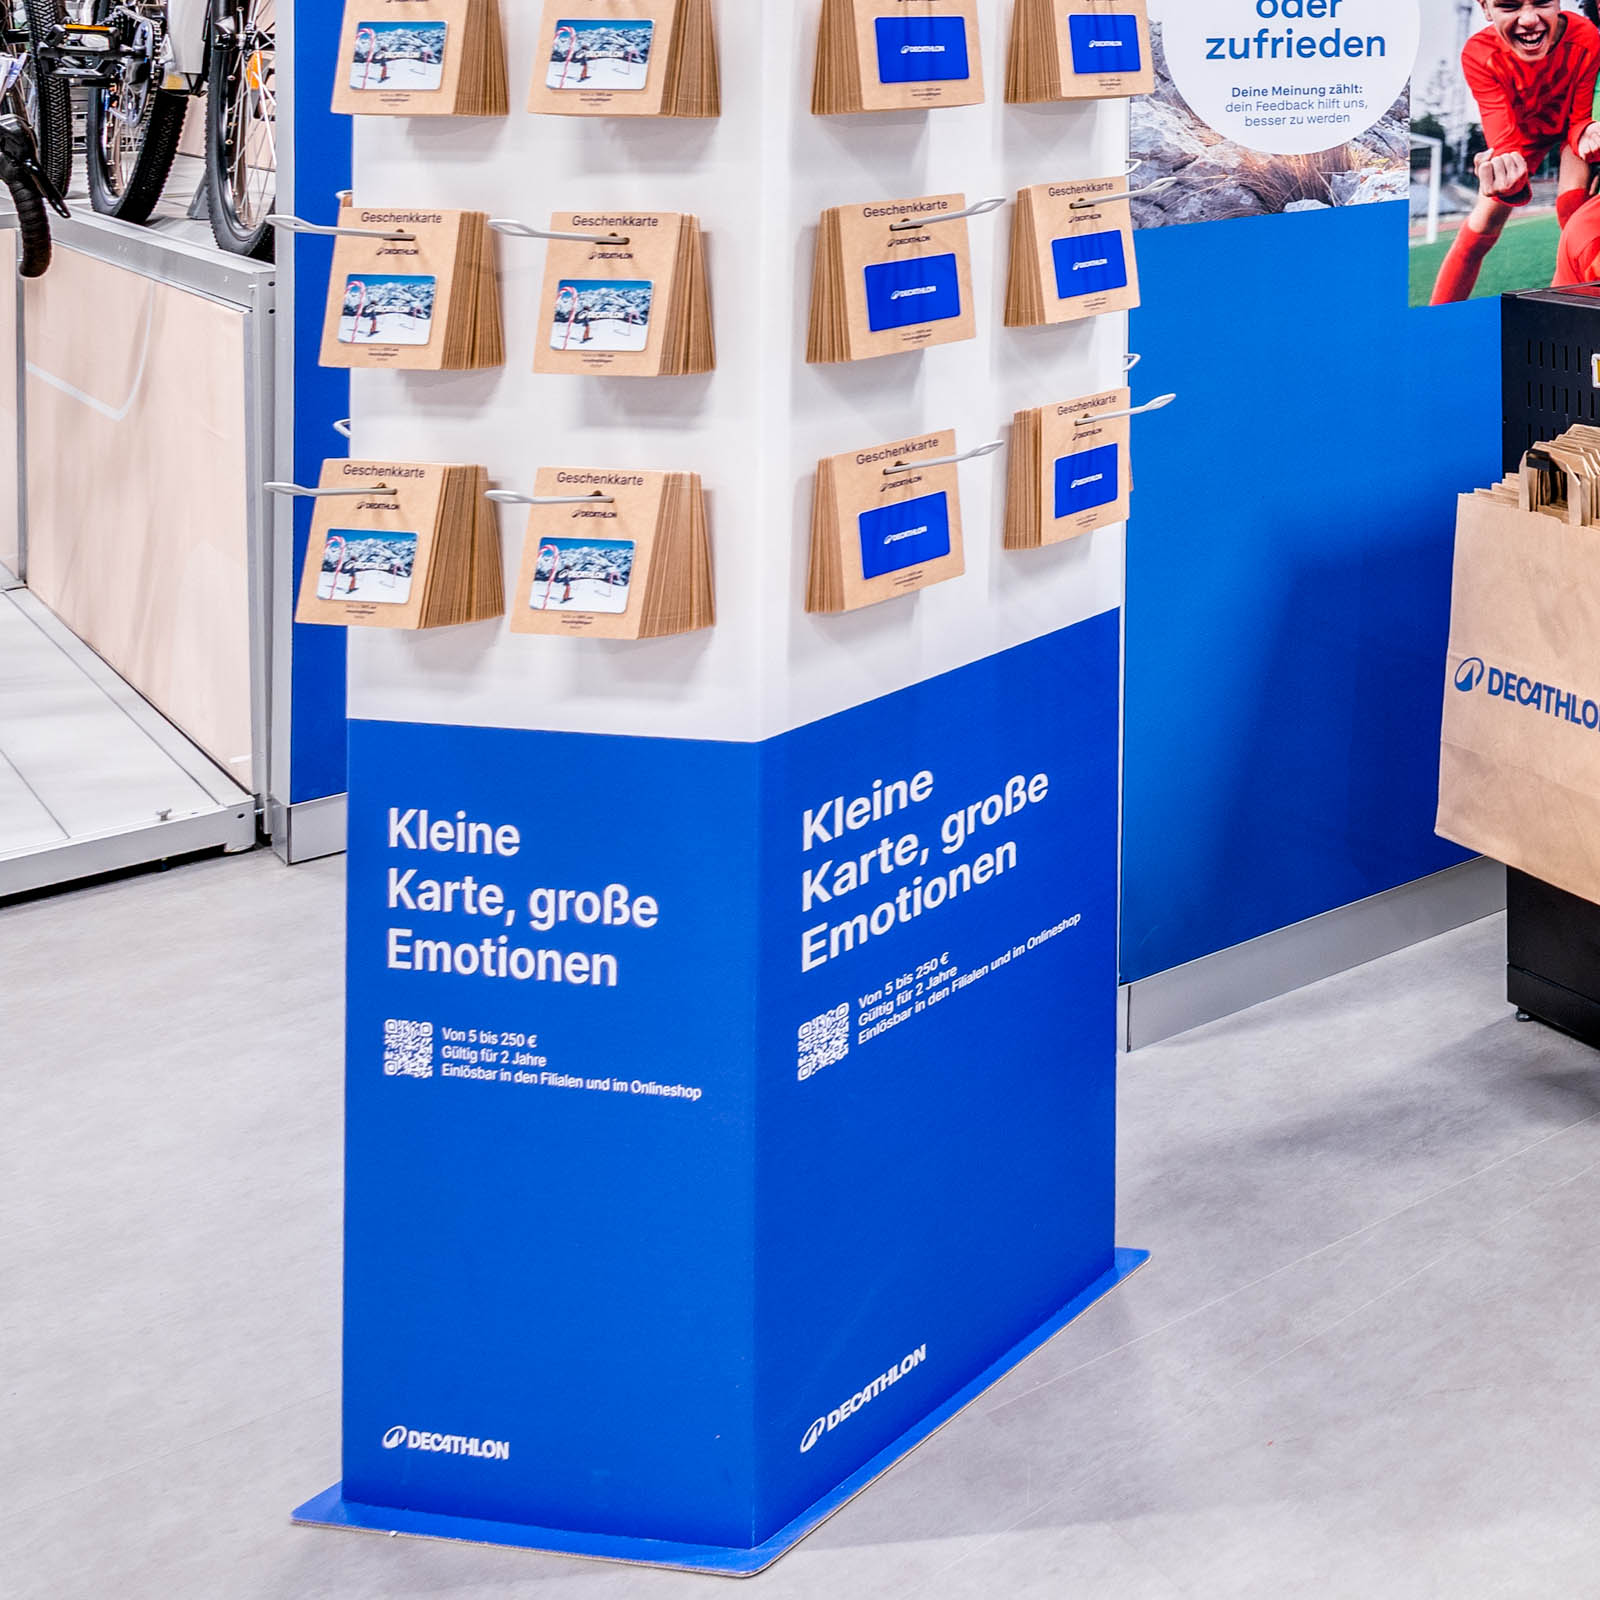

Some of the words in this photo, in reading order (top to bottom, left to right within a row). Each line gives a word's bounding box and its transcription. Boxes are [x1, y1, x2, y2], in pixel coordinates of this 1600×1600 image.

[1206, 28, 1384, 59] zufrieden
[1224, 101, 1253, 113] dein
[1255, 98, 1315, 112] Feedback
[1317, 97, 1341, 110] hilft
[1343, 99, 1369, 110] uns,
[1231, 85, 1269, 98] Deine
[1271, 84, 1327, 98] Meinung
[1328, 83, 1363, 95] zählt:
[1244, 115, 1287, 127] besser
[1289, 115, 1305, 125] zu
[1306, 112, 1351, 125] werden
[1047, 182, 1114, 197] Geschenkkarte
[360, 211, 443, 224] Geschenkkarte
[571, 215, 659, 227] Geschenkkarte
[862, 200, 949, 219] Geschenkkarte
[855, 438, 940, 465] Geschenkkarte
[342, 463, 426, 479] Geschenkkarte
[556, 471, 645, 487] Geschenkkarte
[803, 770, 933, 851] Kleine
[389, 808, 520, 856] Kleine
[802, 834, 929, 912] Karte,
[942, 774, 1048, 854] große
[388, 868, 515, 926] Karte,
[528, 885, 658, 931] große
[802, 842, 1016, 972] Emotionen
[388, 928, 617, 986] Emotionen
[857, 989, 883, 1009] Von
[884, 981, 894, 996] 5
[895, 973, 914, 991] bis
[915, 957, 939, 980] 250
[939, 951, 949, 965] €
[858, 1007, 912, 1044] Einlösbar
[914, 999, 927, 1014] in
[927, 986, 950, 1007] den
[952, 966, 988, 992] Filialen
[990, 949, 1012, 971] und
[1012, 944, 1026, 959] im
[1027, 914, 1080, 949] Onlineshop
[858, 1000, 894, 1026] Gültig
[895, 989, 914, 1007] für
[915, 981, 924, 997] 2
[925, 965, 958, 991] Jahre
[441, 1027, 467, 1042] Von
[467, 1029, 478, 1043] 5
[479, 1030, 499, 1045] bis
[499, 1031, 526, 1048] 250
[525, 1034, 537, 1049] €
[441, 1045, 479, 1065] Gültig
[479, 1047, 499, 1063] für
[499, 1049, 510, 1065] 2
[511, 1051, 547, 1068] Jahre
[441, 1062, 499, 1081] Einlösbar
[499, 1067, 513, 1082] in
[513, 1069, 539, 1085] den
[539, 1071, 585, 1089] Filialen
[585, 1077, 611, 1091] und
[611, 1077, 629, 1093] im
[629, 1079, 703, 1102] Onlineshop
[827, 1344, 926, 1432] DECATHLON
[407, 1430, 509, 1460] DECATHLON
